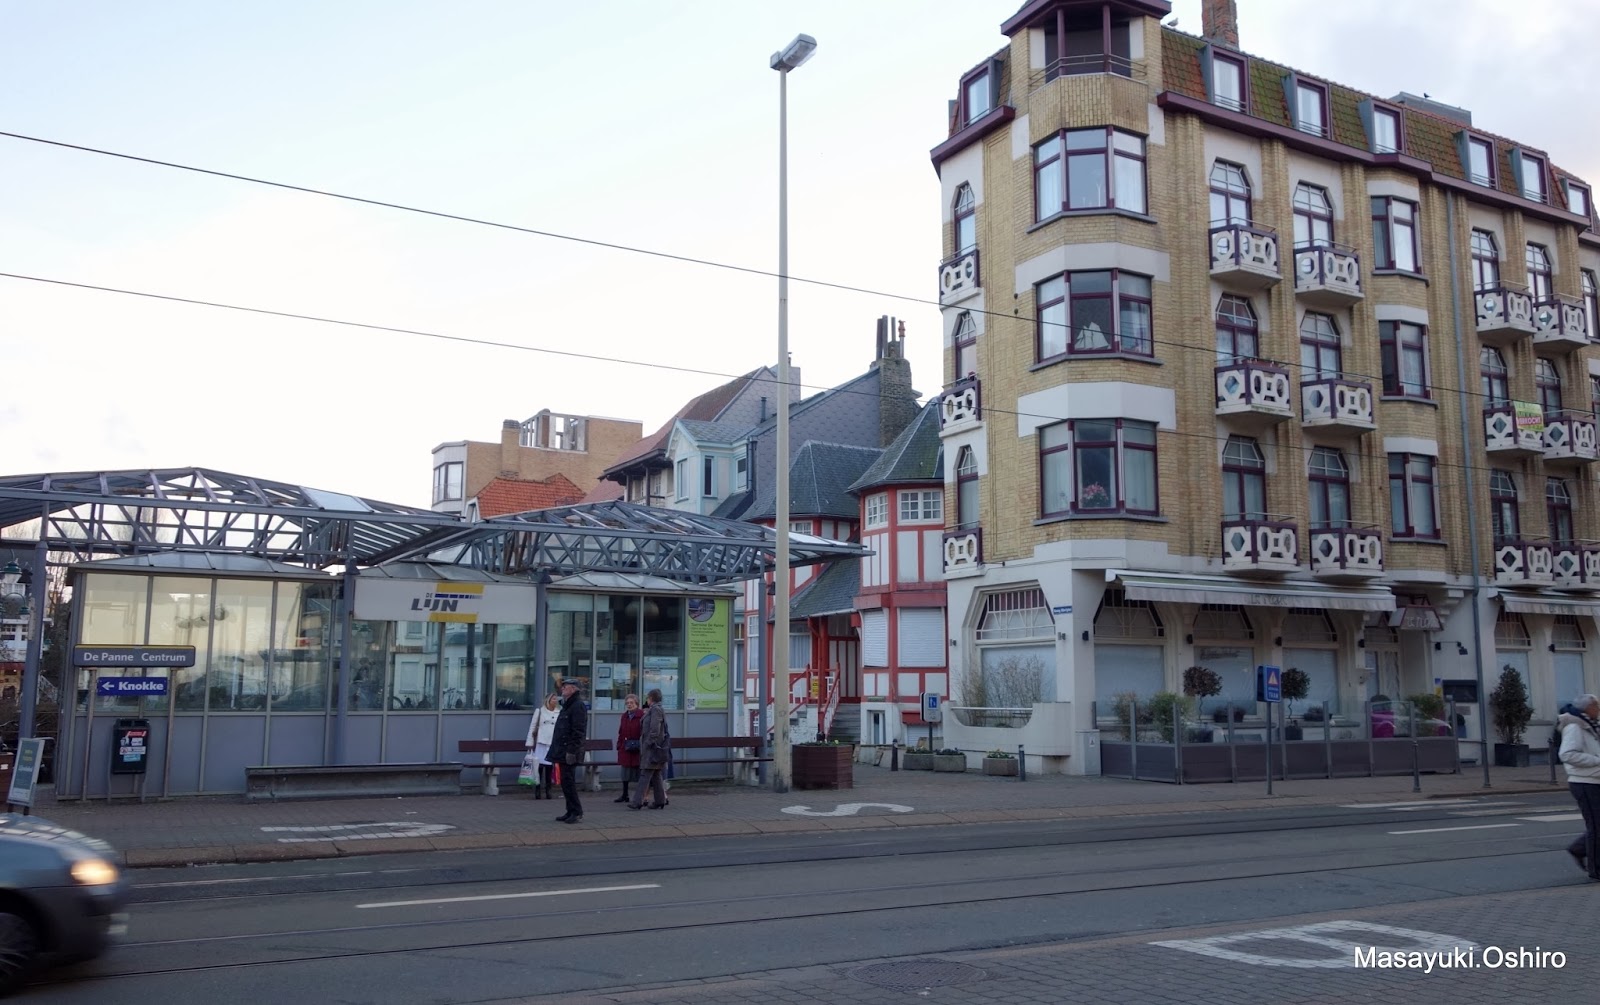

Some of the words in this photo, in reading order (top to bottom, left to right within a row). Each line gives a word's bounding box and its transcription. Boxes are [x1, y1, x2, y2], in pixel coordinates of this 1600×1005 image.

[411, 598, 459, 612] LIJN
[83, 652, 99, 661] De
[101, 652, 134, 662] Panne
[141, 652, 186, 662] Centrum
[118, 681, 164, 691] Knokke
